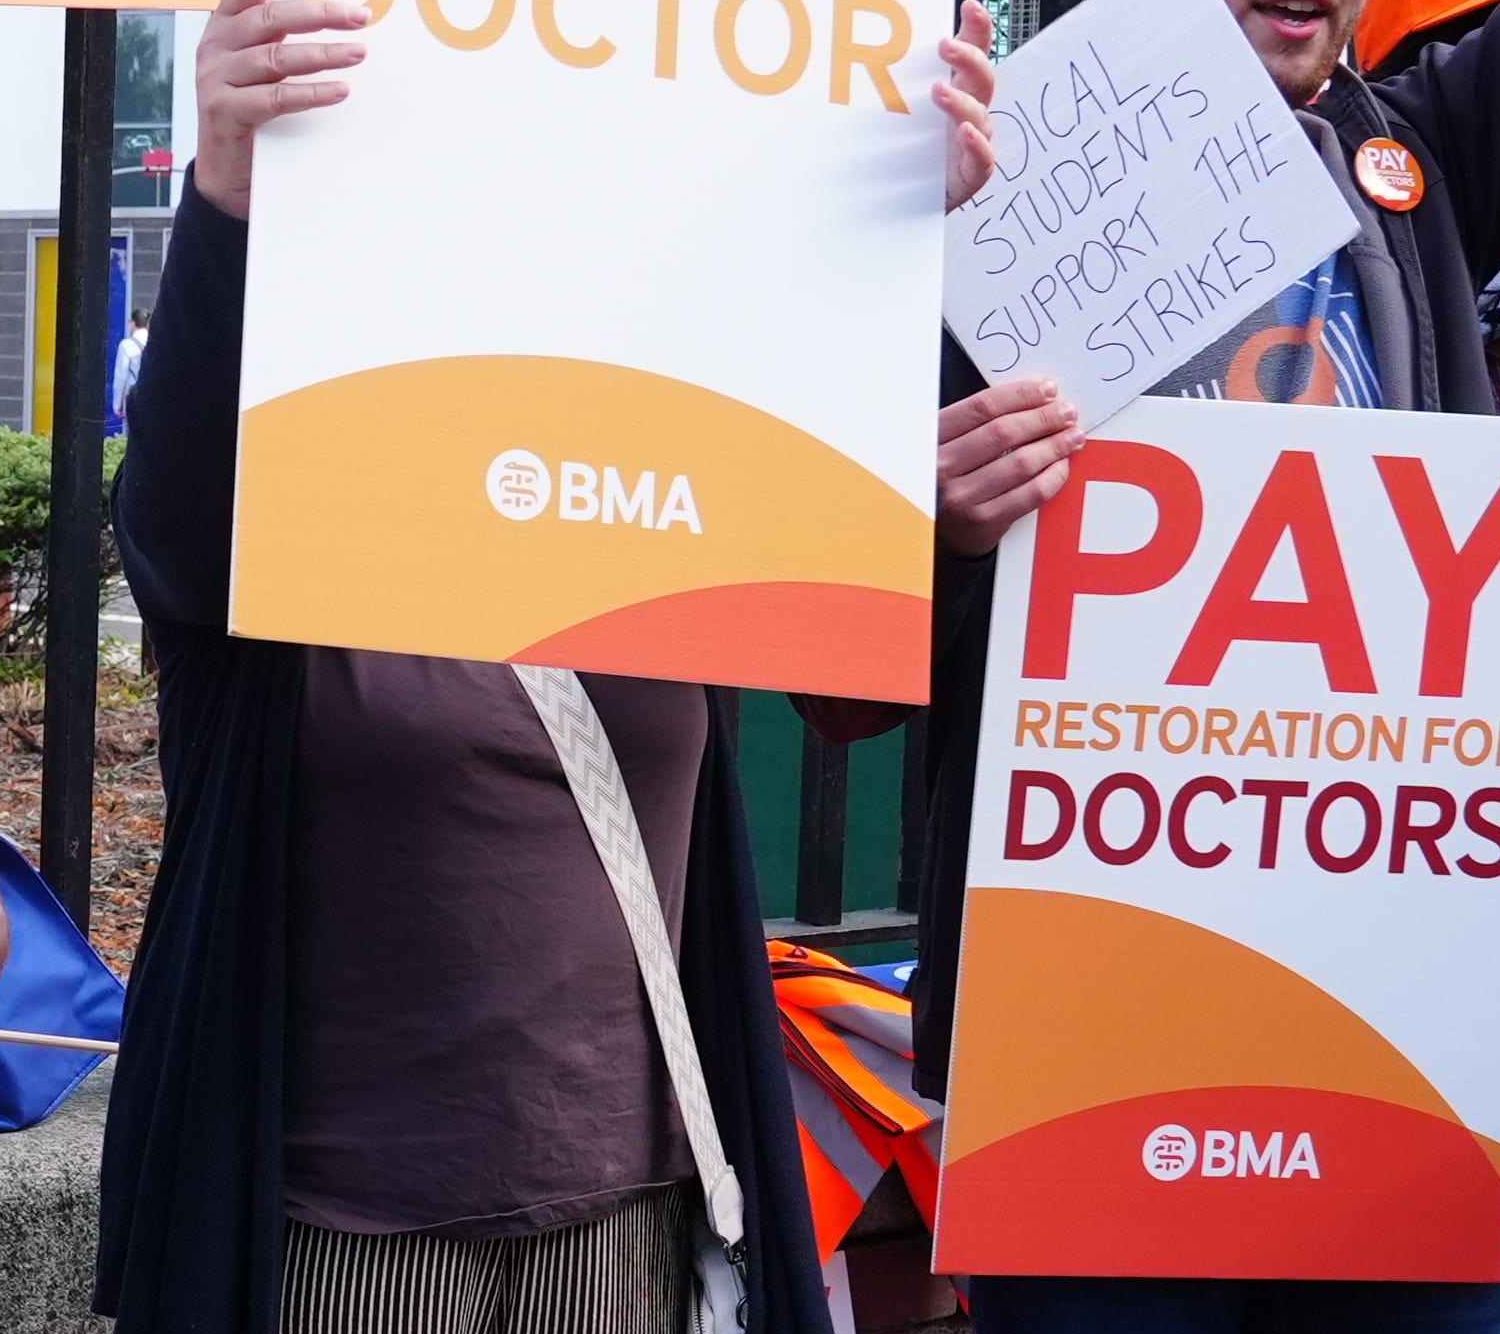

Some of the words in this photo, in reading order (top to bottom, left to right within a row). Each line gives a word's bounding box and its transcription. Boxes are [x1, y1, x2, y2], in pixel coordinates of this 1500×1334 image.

[957, 41, 1150, 211] DICAL
[973, 71, 1208, 275] STUDENTS
[1364, 147, 1408, 171] PAY
[976, 191, 1159, 373] SUPPORT
[1194, 103, 1289, 204] THE
[1086, 216, 1276, 382] STRIKES
[557, 461, 704, 535] BMA
[1014, 699, 1407, 763] RESTORATION
[1201, 1130, 1321, 1181] BMA
